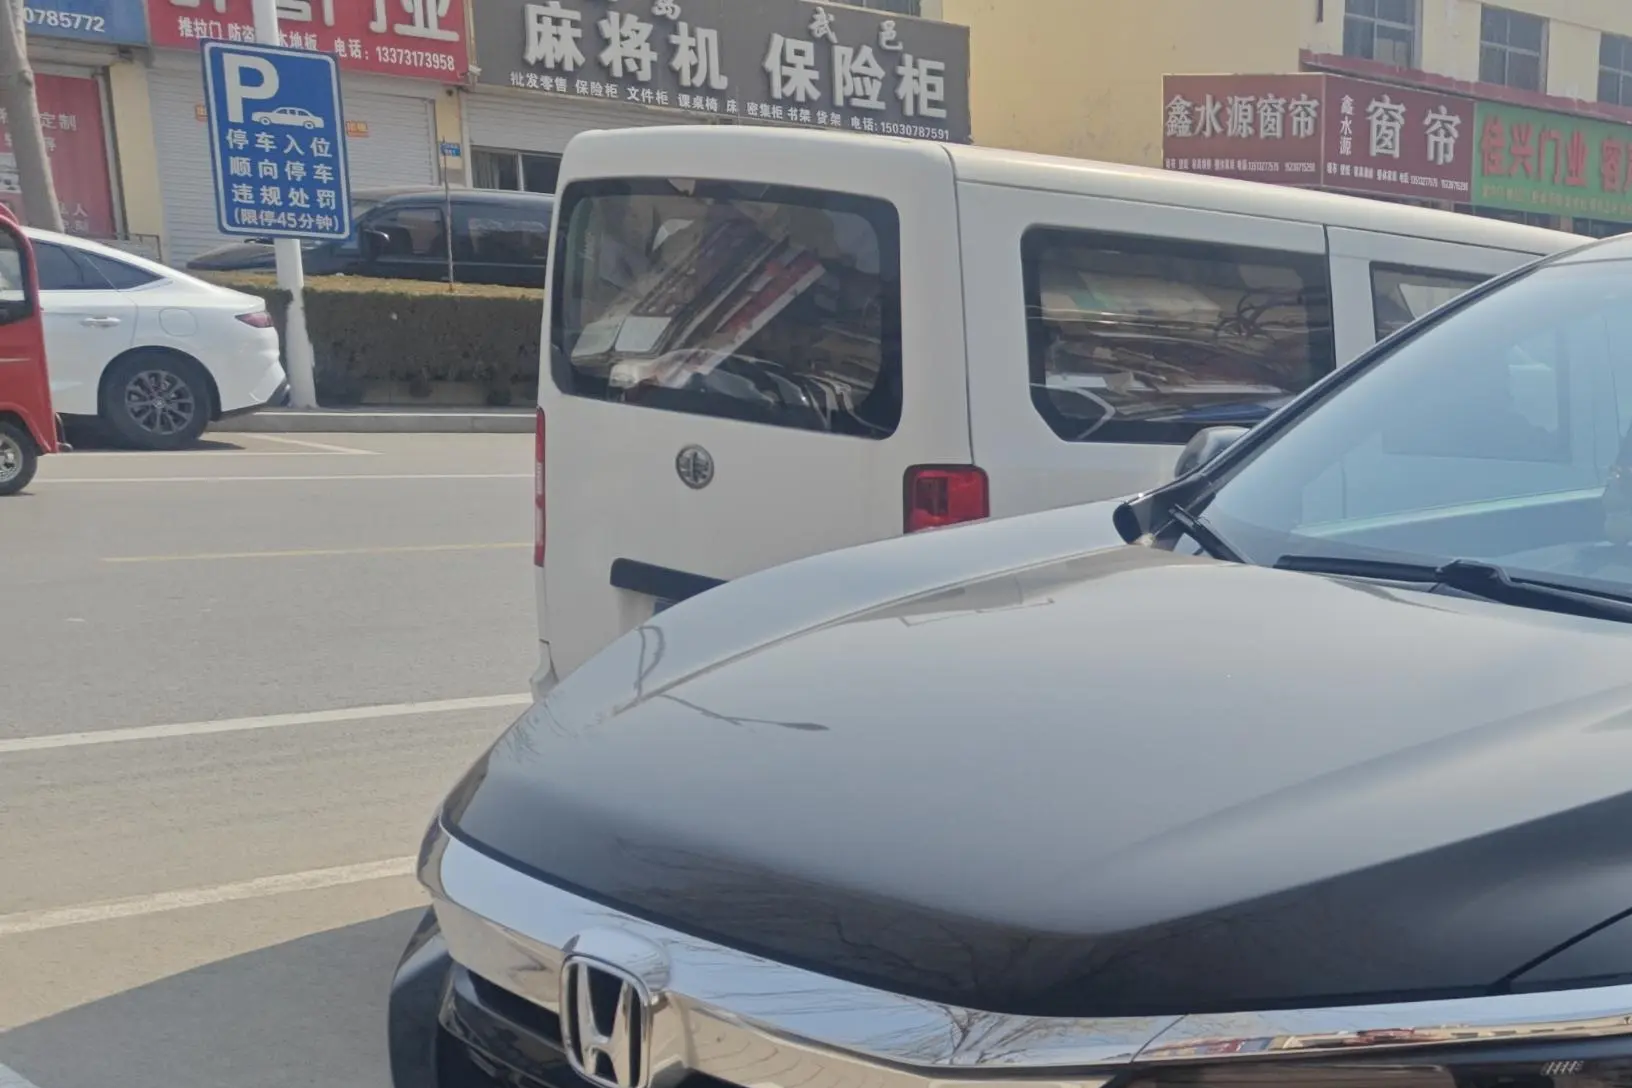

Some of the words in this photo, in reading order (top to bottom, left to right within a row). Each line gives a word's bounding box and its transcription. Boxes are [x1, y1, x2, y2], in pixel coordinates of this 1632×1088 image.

[177, 15, 223, 40] 推拉门
[523, 1, 729, 90] 麻将机
[762, 33, 948, 119] 保险柜
[222, 53, 280, 123] P
[510, 71, 568, 93] 批发零售
[575, 79, 619, 99] 保险柜
[626, 86, 669, 106] 文件柜
[677, 93, 718, 113] 课桌椅
[746, 102, 784, 121] 密集柜
[787, 107, 812, 122] 书架
[816, 109, 842, 127] 货架
[1165, 93, 1320, 139] 鑫水源窗帘
[1339, 94, 1353, 156] 鑫水源
[1365, 93, 1461, 166] 窗帘
[226, 128, 333, 158] 停车入位
[229, 156, 335, 184] 顺向停车
[231, 183, 336, 211] 违规处罚
